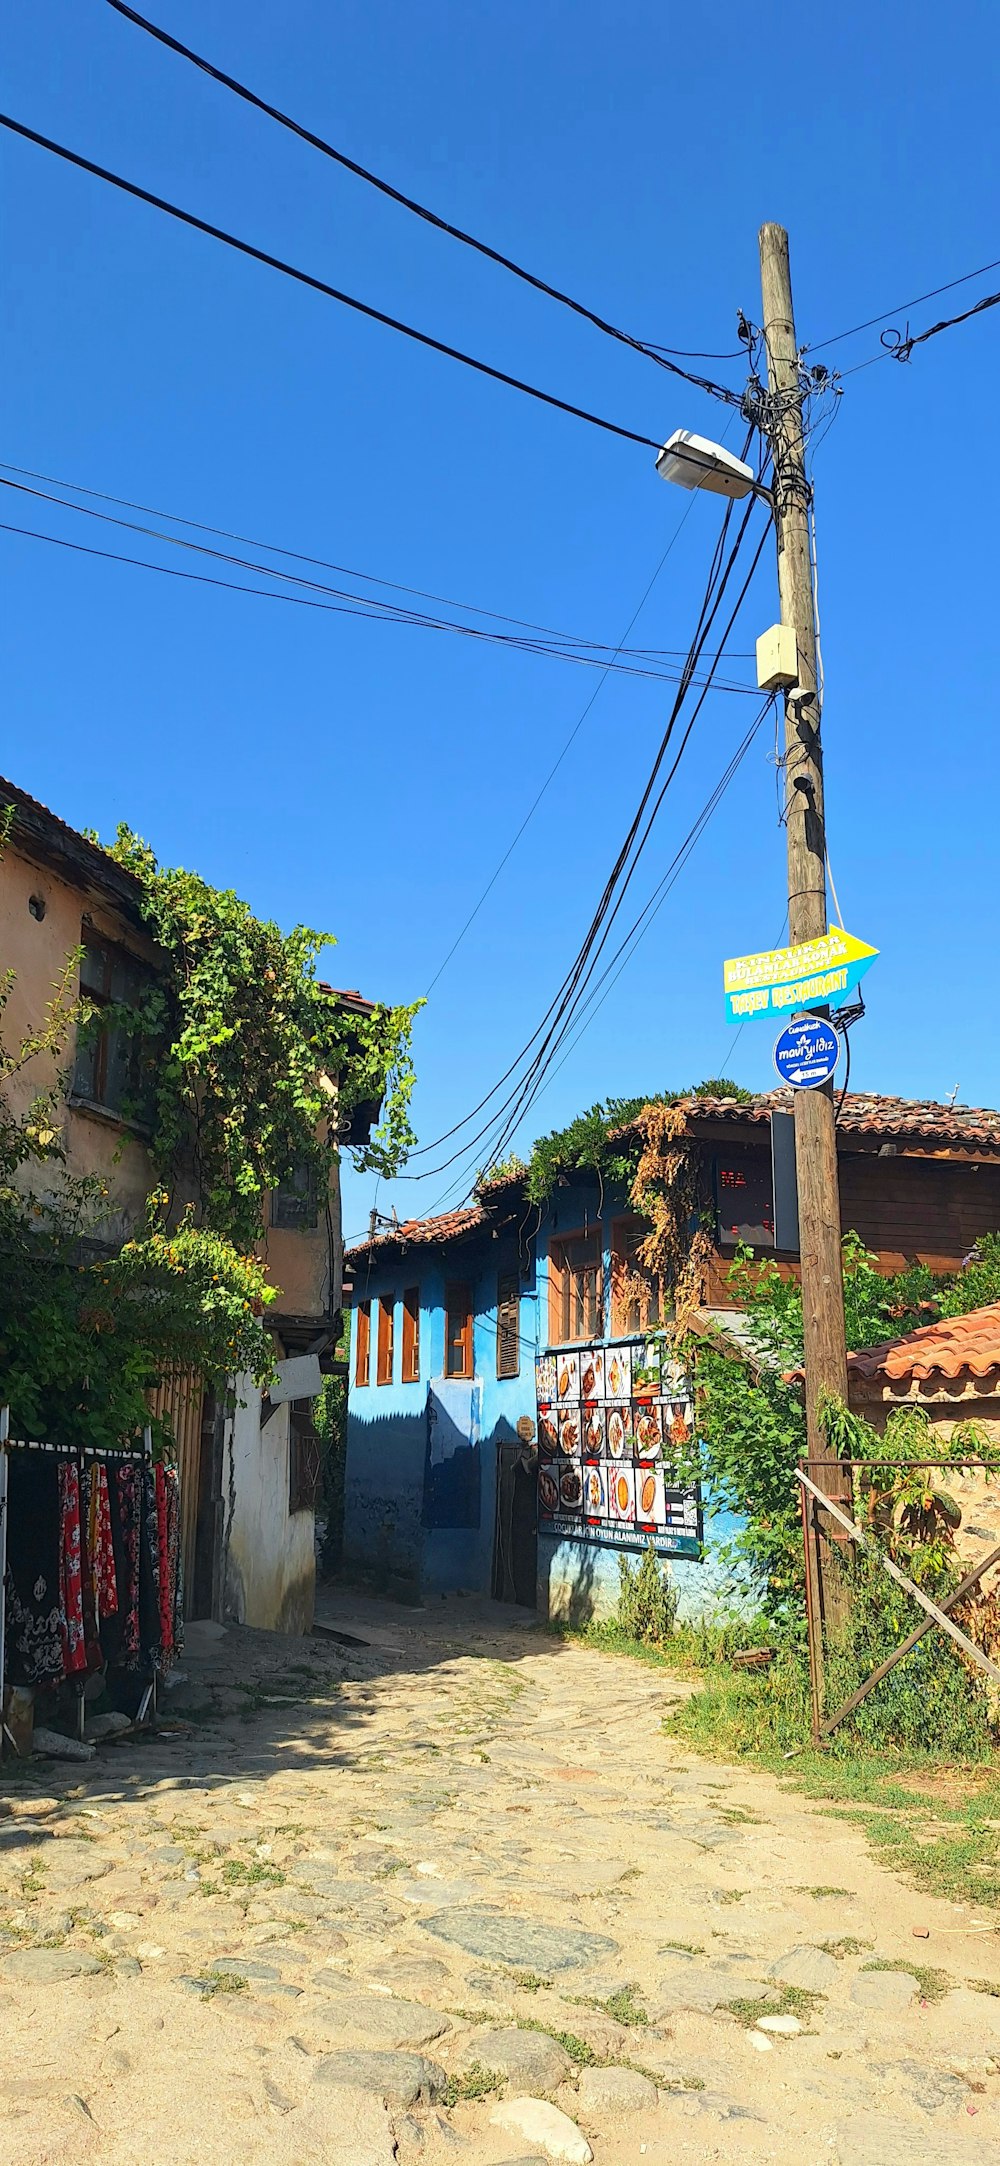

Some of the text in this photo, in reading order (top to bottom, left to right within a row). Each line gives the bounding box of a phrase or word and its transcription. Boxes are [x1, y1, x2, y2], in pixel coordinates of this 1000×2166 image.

[802, 942, 847, 965] KONAK
[745, 959, 832, 985] RESTAURANT
[730, 968, 848, 1016] TAŞEV RESTAURANT
[595, 1529, 614, 1540] OYUN
[614, 1532, 646, 1544] ALANIMIZ
